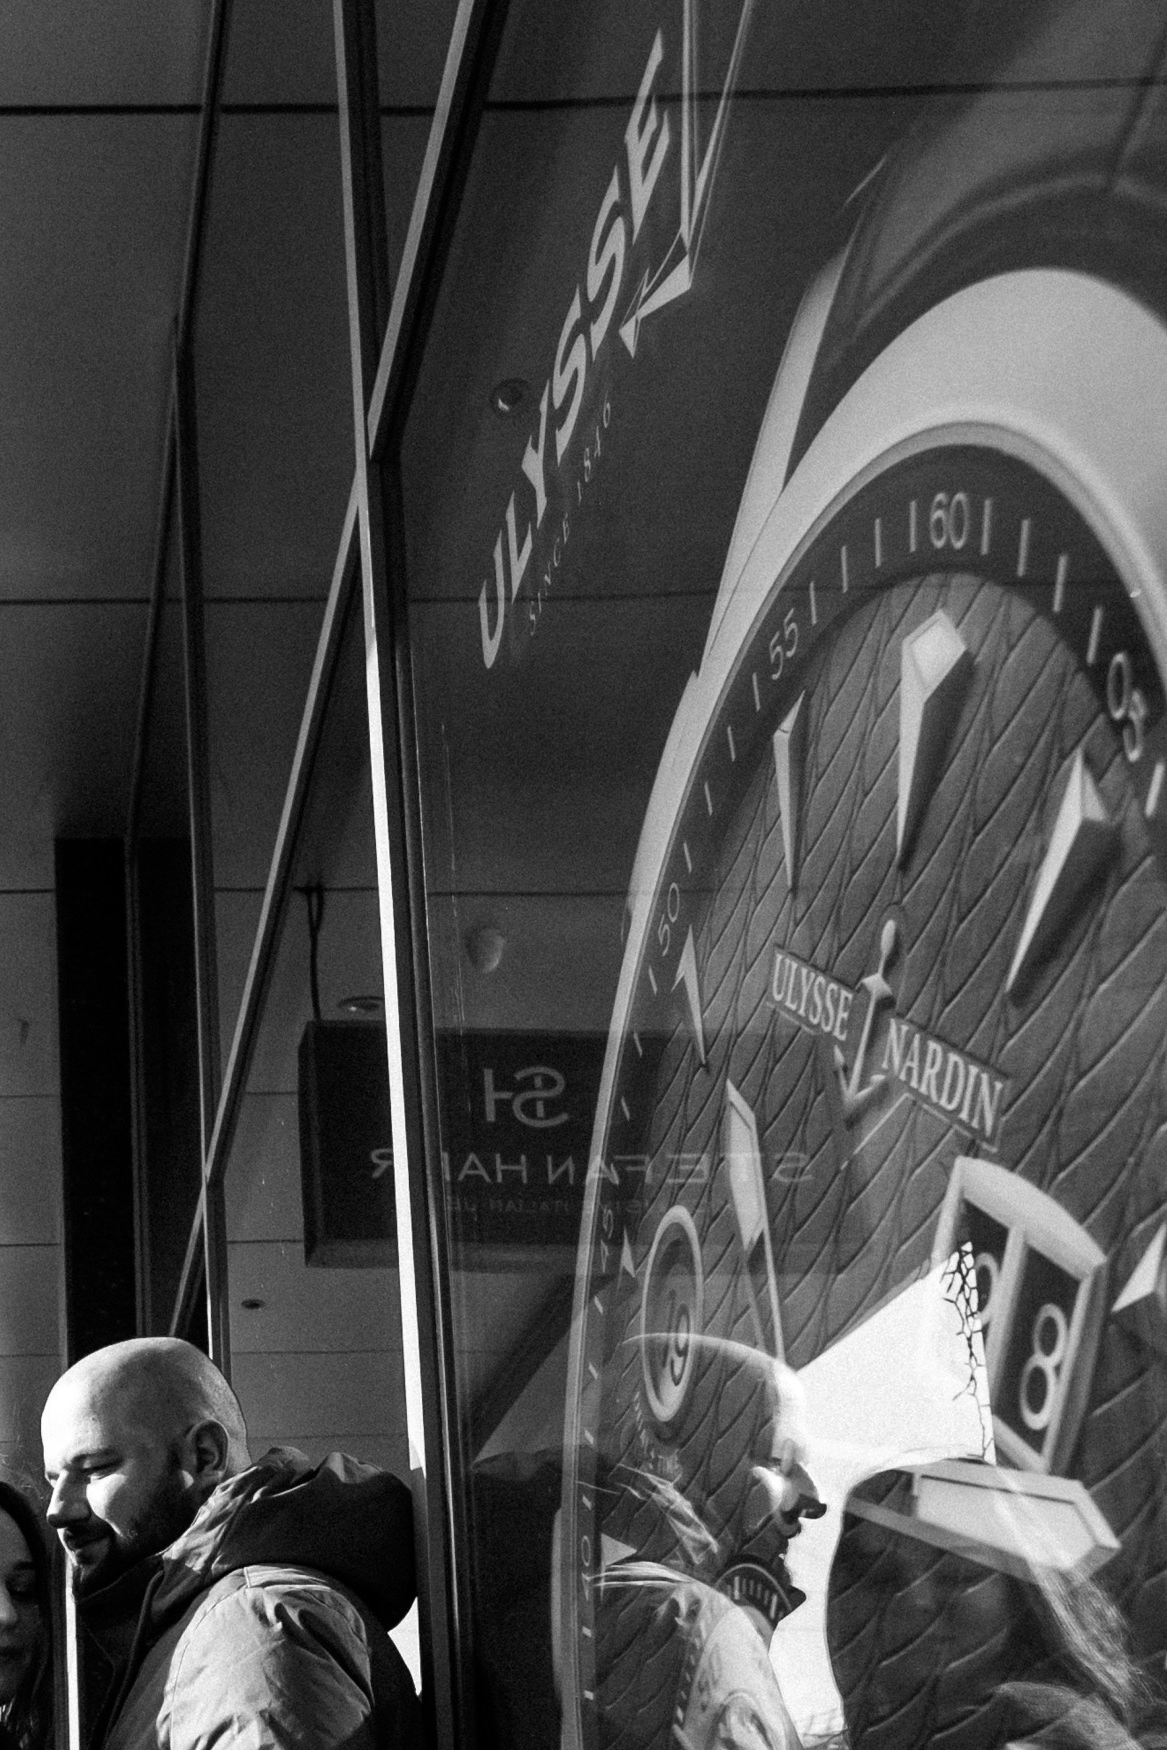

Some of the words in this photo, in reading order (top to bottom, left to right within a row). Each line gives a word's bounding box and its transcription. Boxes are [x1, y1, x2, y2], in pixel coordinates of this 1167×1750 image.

[477, 26, 670, 669] ULYSSE
[928, 491, 969, 550] 60
[767, 608, 800, 681] 55
[657, 880, 681, 956] 50
[772, 952, 854, 1042] ULYSSE
[881, 1017, 1004, 1138] NARDIN
